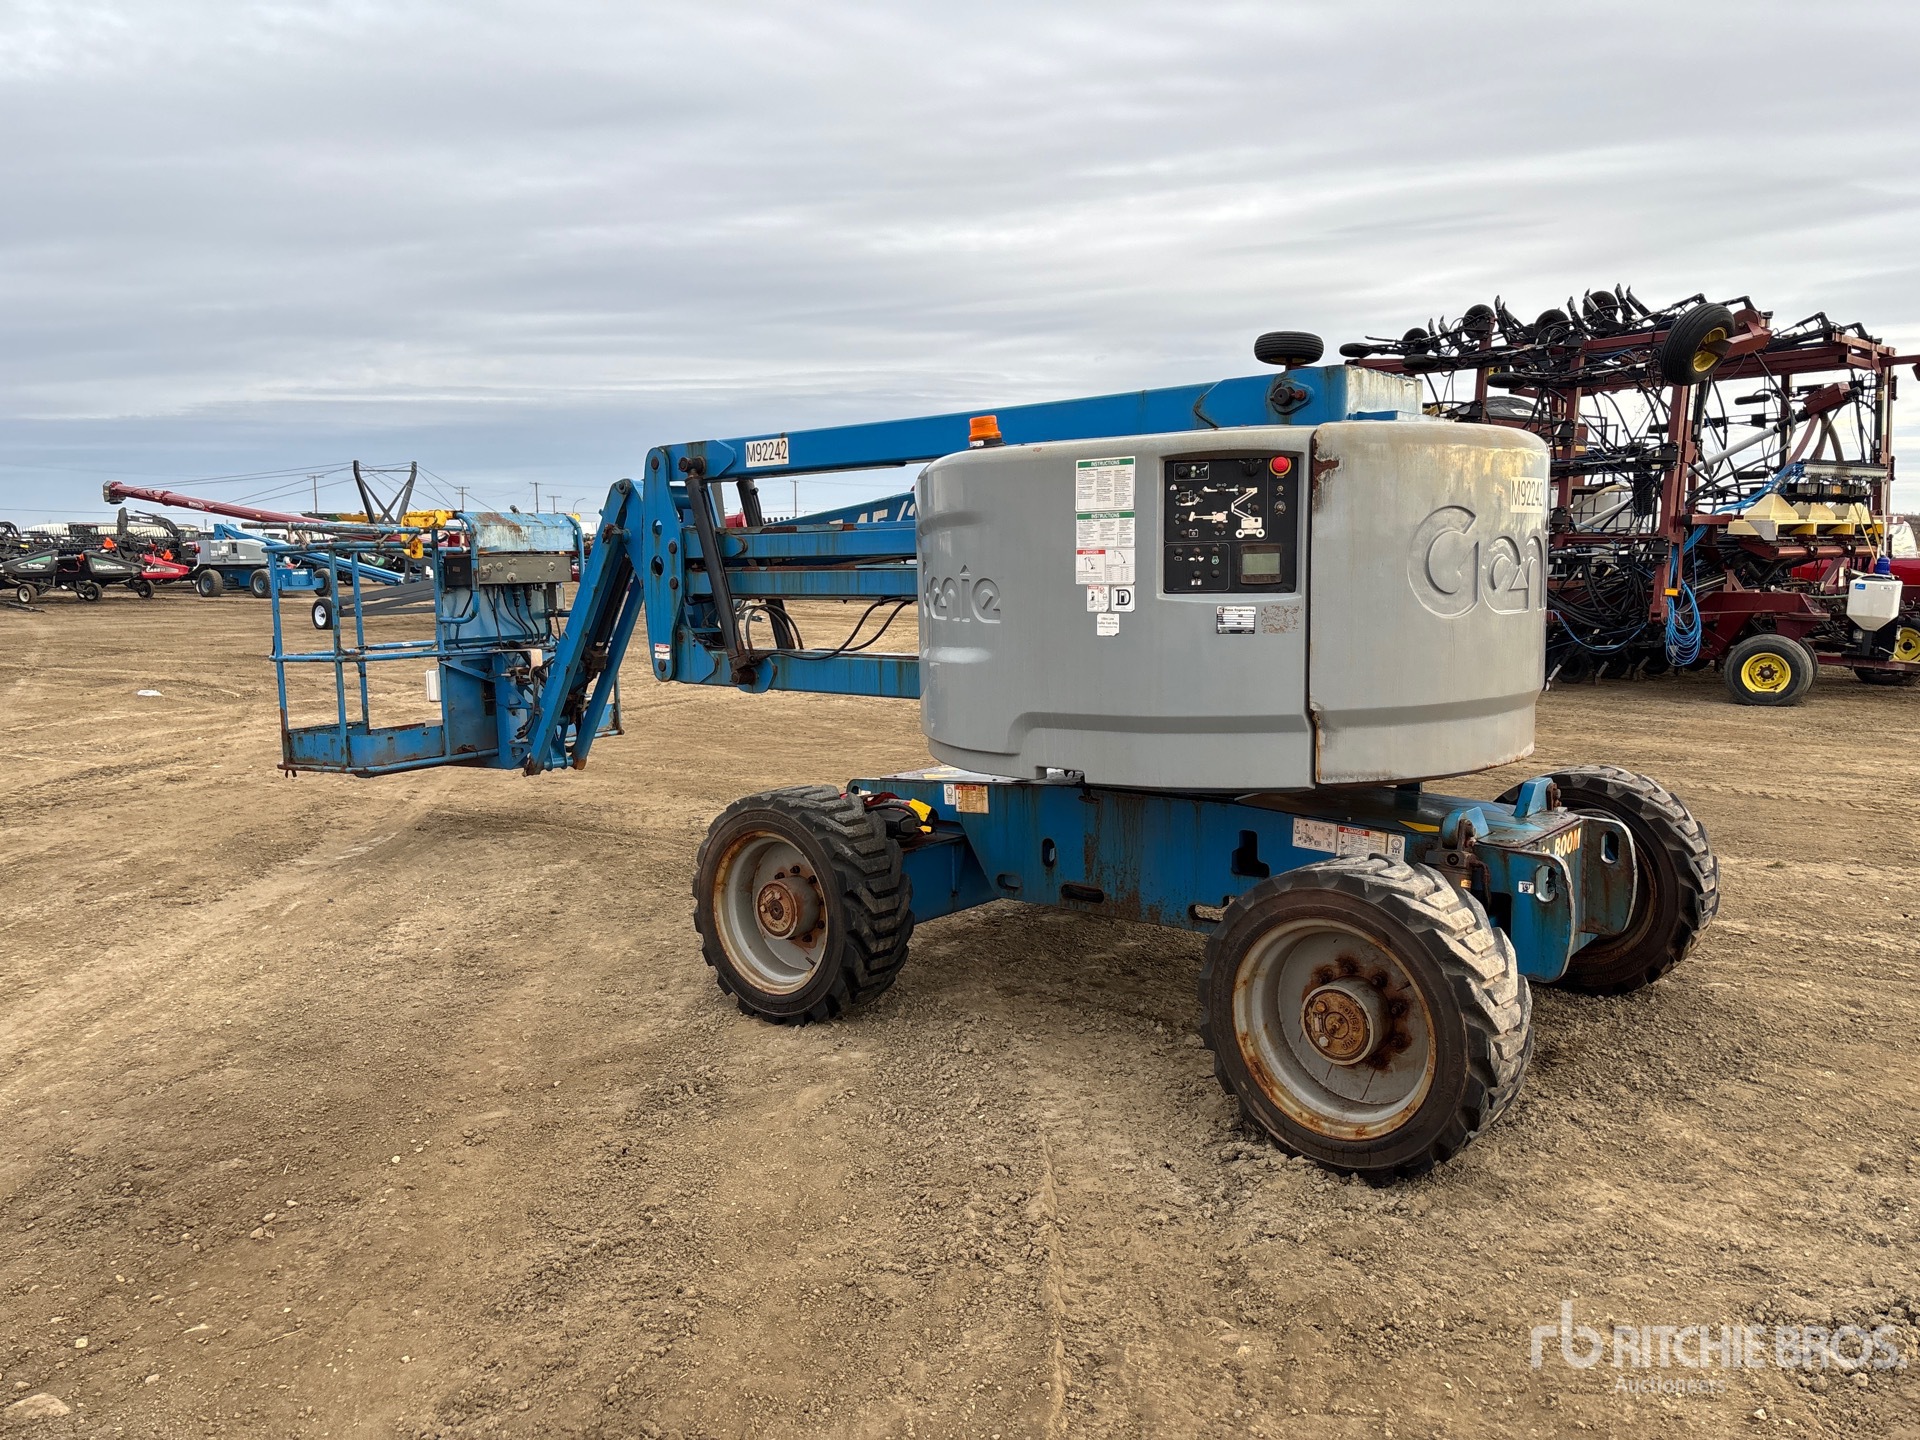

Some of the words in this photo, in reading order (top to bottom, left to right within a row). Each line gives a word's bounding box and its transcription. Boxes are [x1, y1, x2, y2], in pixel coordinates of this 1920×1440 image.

[746, 440, 787, 463] M92242
[1511, 480, 1543, 507] M92242
[1115, 589, 1131, 606] D
[1347, 828, 1366, 836] DANGER
[1554, 827, 1582, 858] BOOM
[1338, 1002, 1360, 1032] POWER
